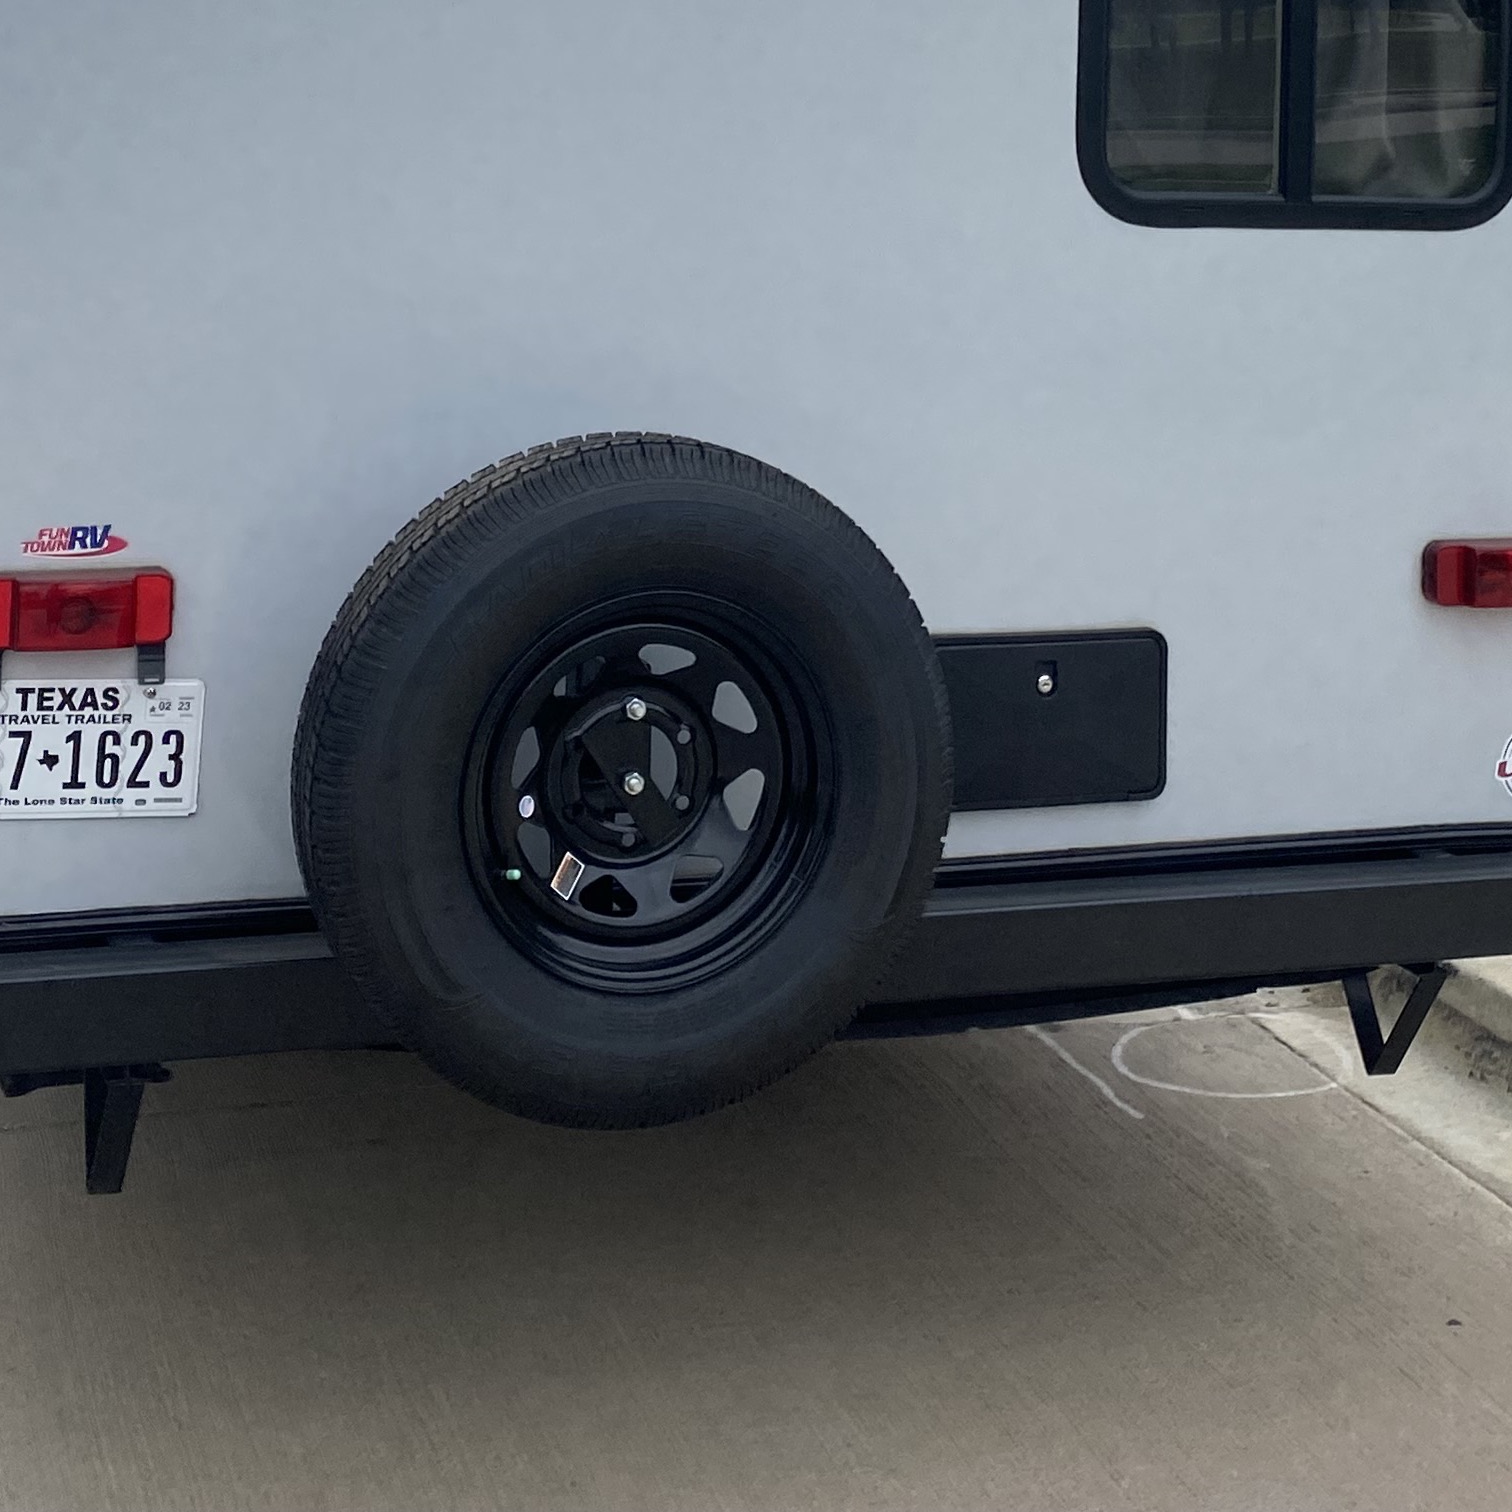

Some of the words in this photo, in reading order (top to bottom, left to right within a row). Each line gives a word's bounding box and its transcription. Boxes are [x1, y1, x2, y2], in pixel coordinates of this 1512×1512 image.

[38, 528, 70, 540] FUN
[67, 523, 112, 550] RV
[21, 540, 68, 554] TOWN
[15, 686, 121, 712] TEXAS
[177, 701, 191, 711] 23
[65, 713, 133, 725] TRAILER
[24, 797, 55, 806] Lone
[59, 796, 86, 805] Star
[90, 796, 124, 805] State
